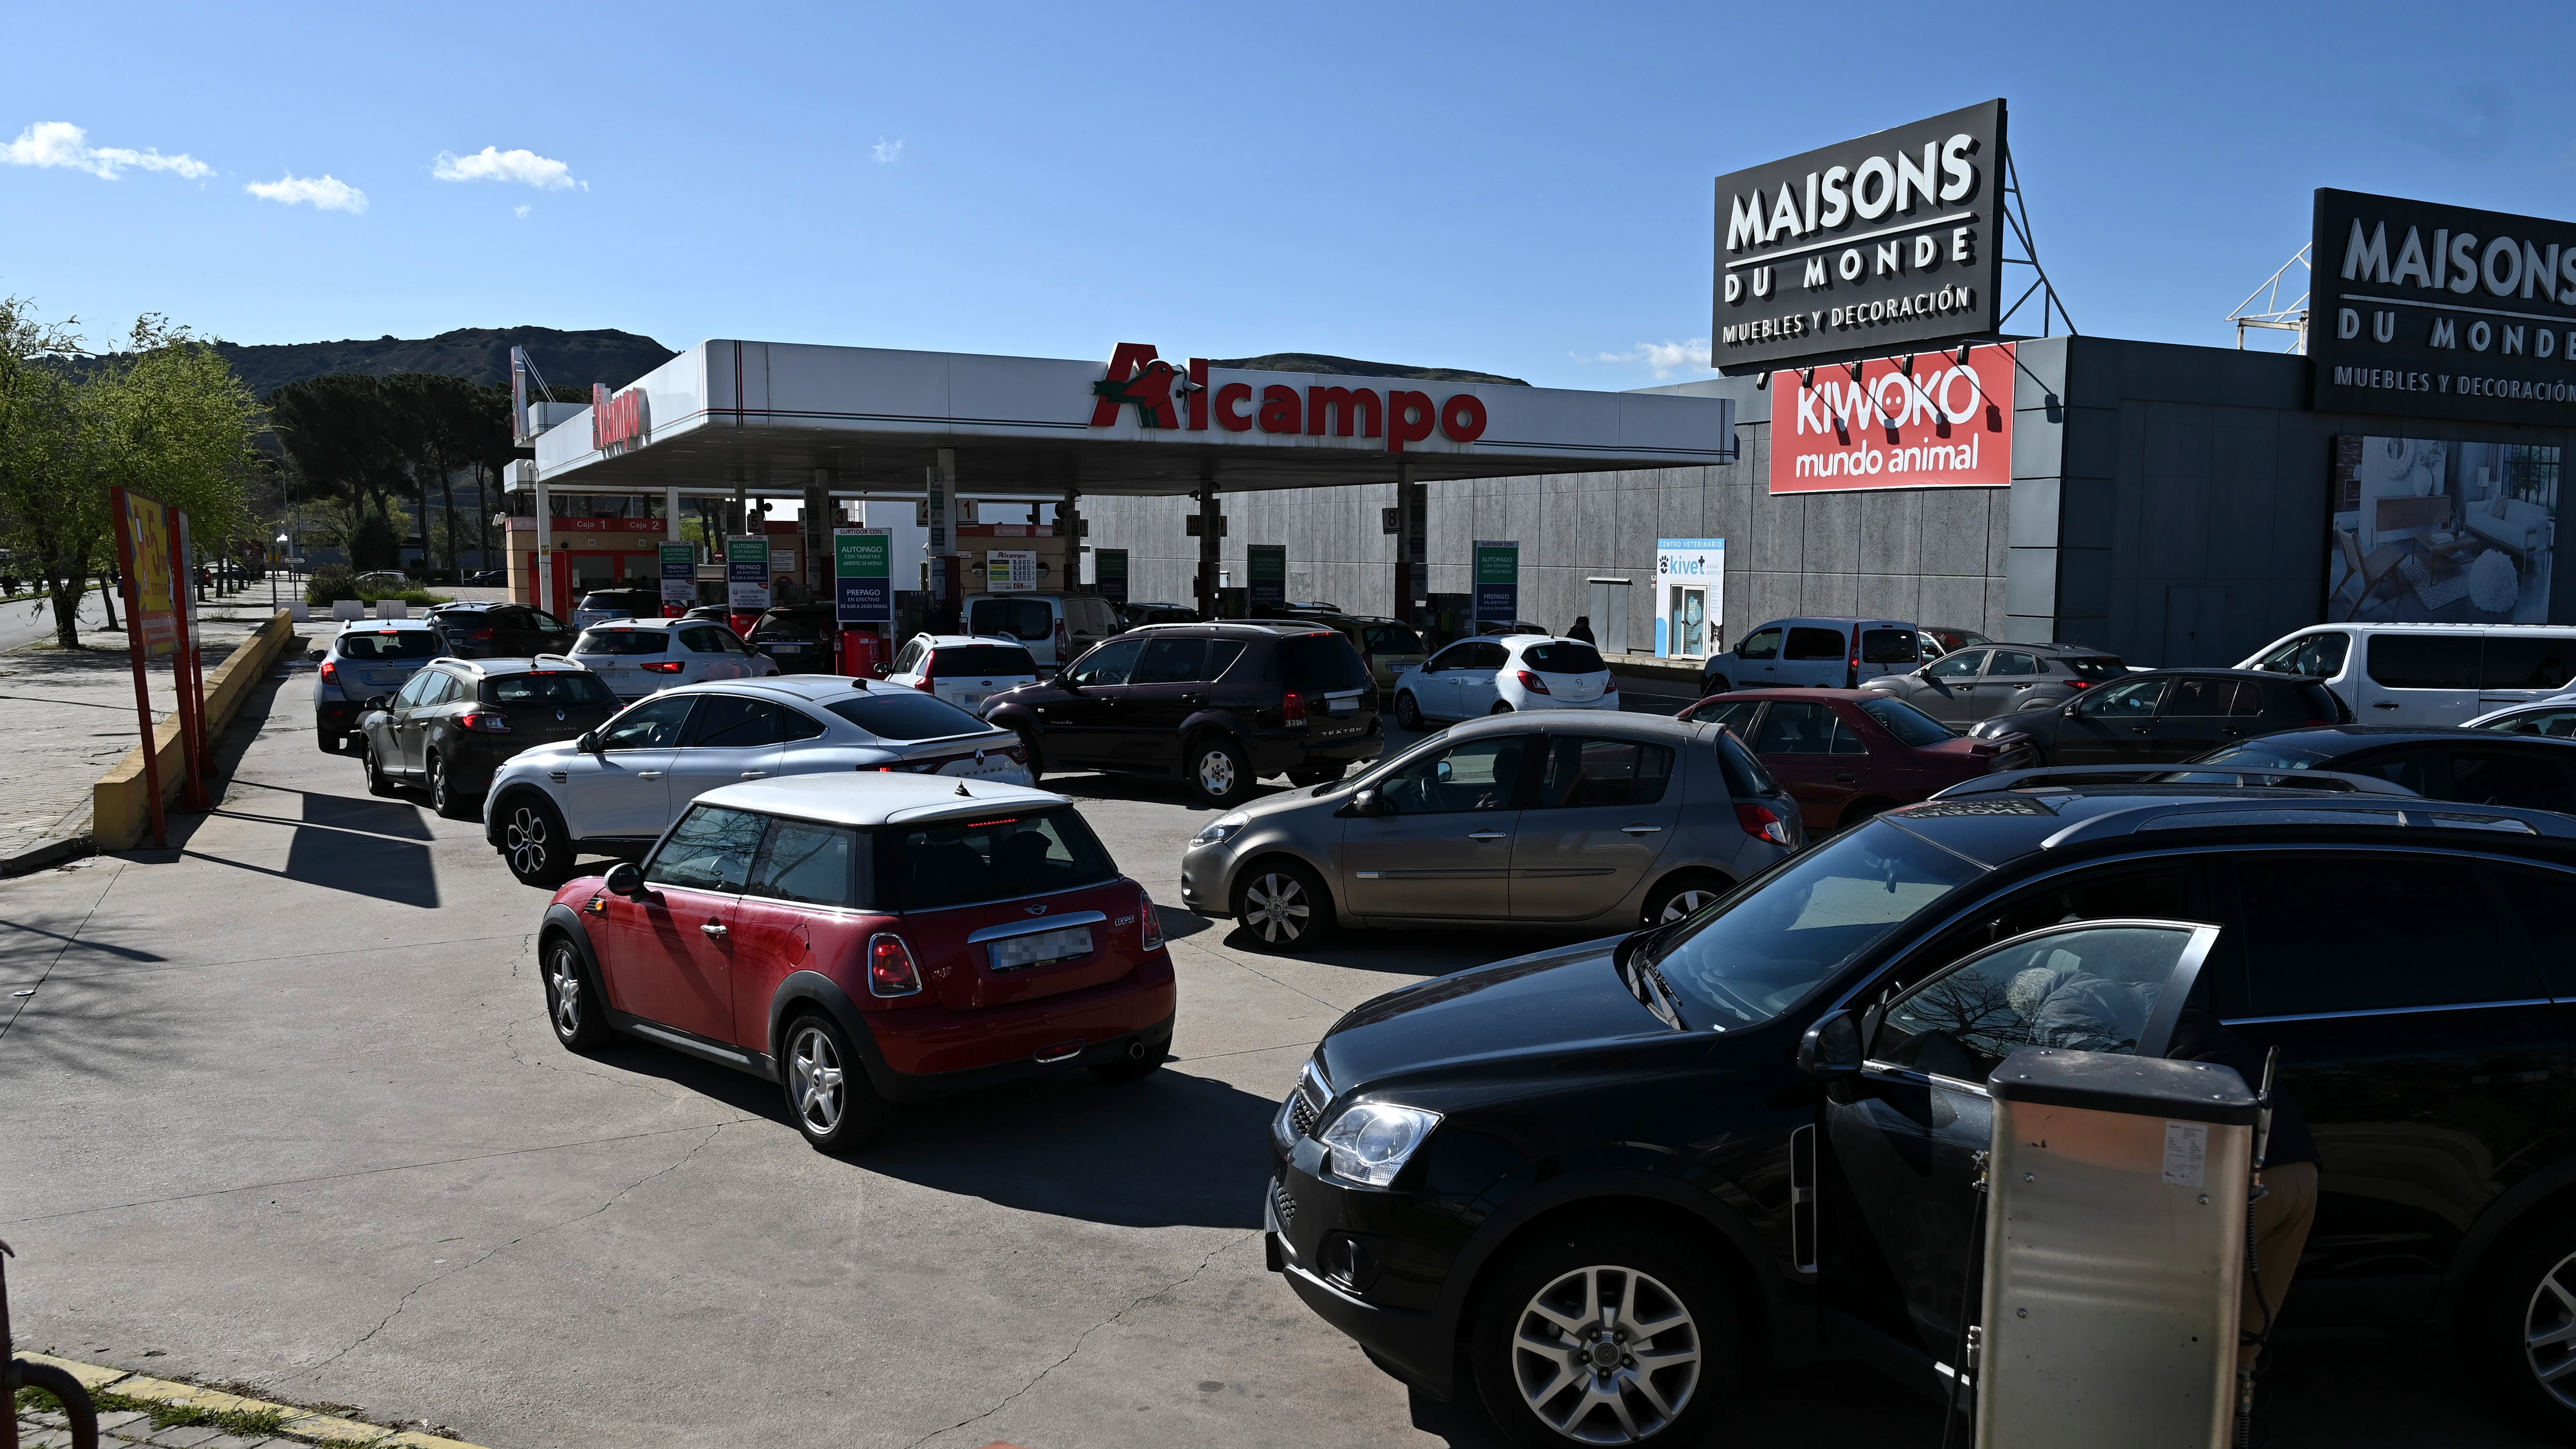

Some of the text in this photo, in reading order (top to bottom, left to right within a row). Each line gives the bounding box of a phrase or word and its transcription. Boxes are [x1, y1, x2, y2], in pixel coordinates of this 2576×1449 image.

[1726, 133, 1972, 250] MAISONS
[1725, 227, 1970, 302] DU MONDE
[1723, 284, 1969, 343] MUEBLES Y DECORACIÓN
[2338, 307, 2394, 343] DU
[2335, 366, 2429, 392] MUEBLES
[2437, 375, 2450, 393] Y
[1088, 342, 1487, 453] Alcampo
[1797, 364, 1981, 435] KIWOKO
[593, 383, 645, 450] Alcampo
[1796, 432, 1979, 478] mundo animal
[836, 510, 844, 525] 3
[964, 500, 971, 519] 1
[1388, 510, 1397, 527] 8
[601, 520, 606, 530] 1
[652, 520, 659, 530] 2
[751, 515, 758, 528] 5
[1054, 520, 1063, 531] 12
[1188, 517, 1199, 530] 10
[1670, 555, 1705, 575] kivet
[1321, 727, 1361, 736] REXTON
[956, 767, 1002, 777] ARKANA
[1114, 914, 1135, 927] COOPER
